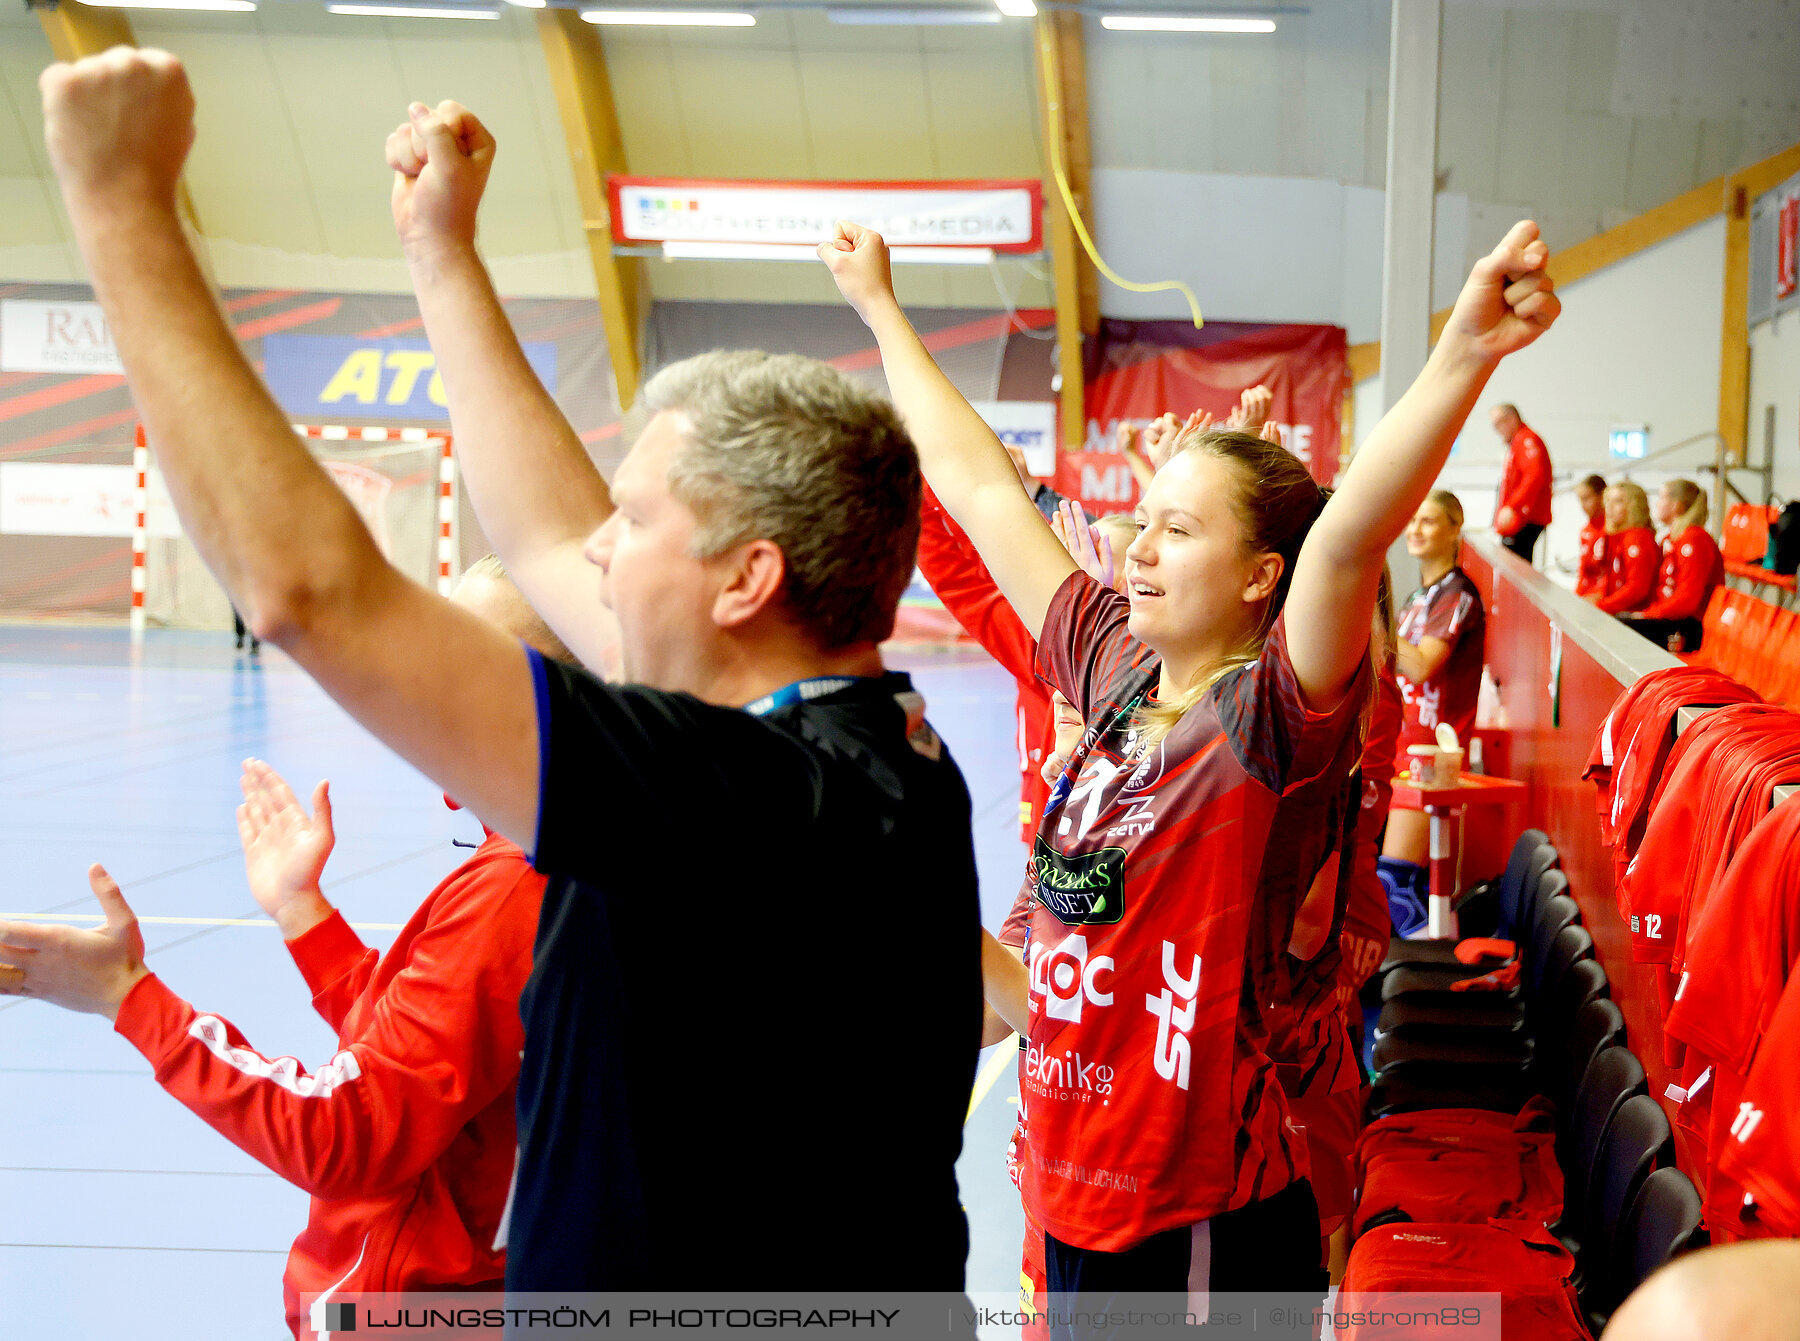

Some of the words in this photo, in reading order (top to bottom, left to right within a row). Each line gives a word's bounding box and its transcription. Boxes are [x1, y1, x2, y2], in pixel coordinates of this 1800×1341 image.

[639, 212, 824, 232] SOUTHERN
[909, 215, 1018, 236] MEDIA
[1644, 914, 1662, 939] 12
[1145, 939, 1202, 1091] stc
[1730, 1102, 1763, 1143] 11
[1113, 1173, 1138, 1193] KAN
